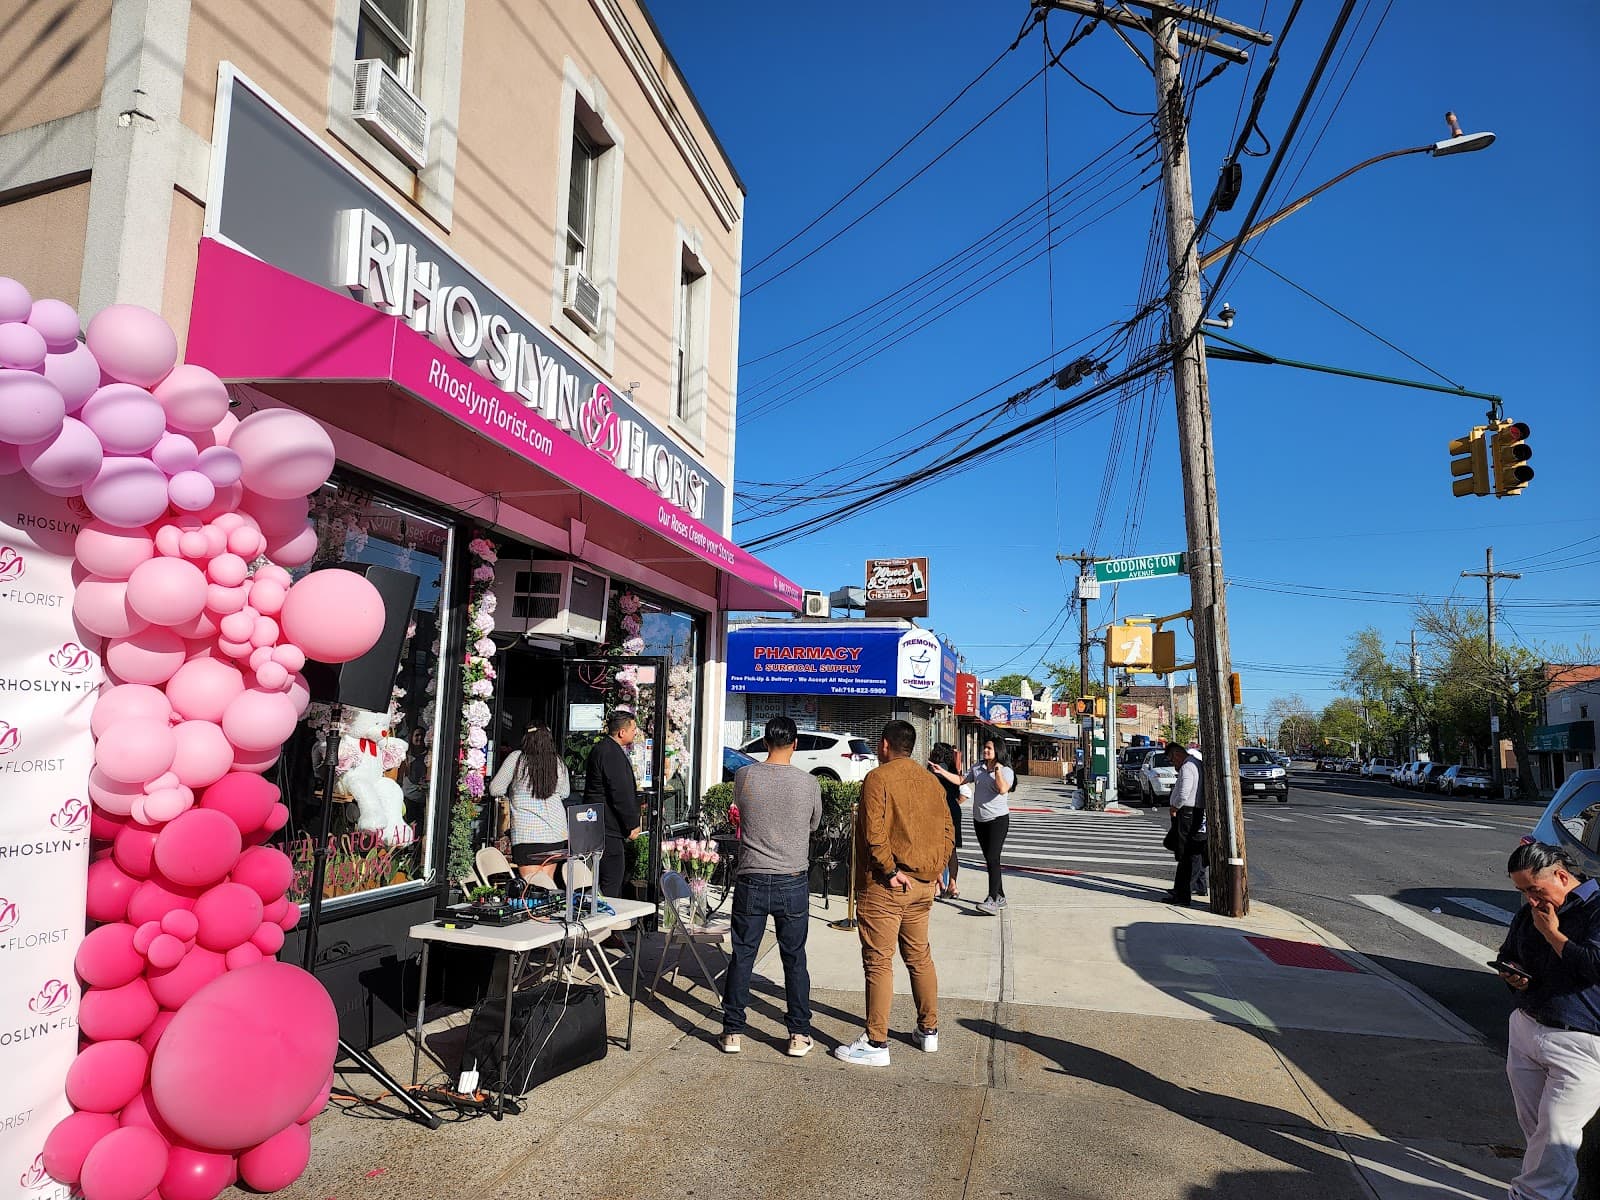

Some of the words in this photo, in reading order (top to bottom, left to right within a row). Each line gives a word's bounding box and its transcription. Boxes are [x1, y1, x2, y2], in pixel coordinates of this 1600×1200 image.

[346, 208, 579, 432] RHOSLYN
[428, 358, 553, 456] Rhoslynflorist.com
[620, 419, 709, 520] FLORIST
[17, 513, 81, 535] RHOSLYN
[658, 506, 671, 526] Our
[671, 513, 688, 538] Roses
[689, 525, 706, 549] Create
[706, 540, 719, 553] your
[1106, 555, 1176, 573] CODDINGTON
[1128, 569, 1155, 579] AVENUE
[10, 589, 64, 607] FLORIST
[754, 646, 863, 661] PHARMACY
[902, 638, 938, 651] TREMONT
[755, 663, 763, 672] &
[765, 663, 817, 673] SURGICAL
[820, 664, 861, 674] SUPPLY
[0, 678, 71, 692] RHOSLYN
[903, 678, 935, 687] CHEMIST
[966, 682, 975, 713] NAILS
[5, 758, 65, 774] FLORIST
[350, 827, 386, 851] FOR
[0, 840, 72, 858] RHOSLYN
[9, 928, 69, 951] FLORIST
